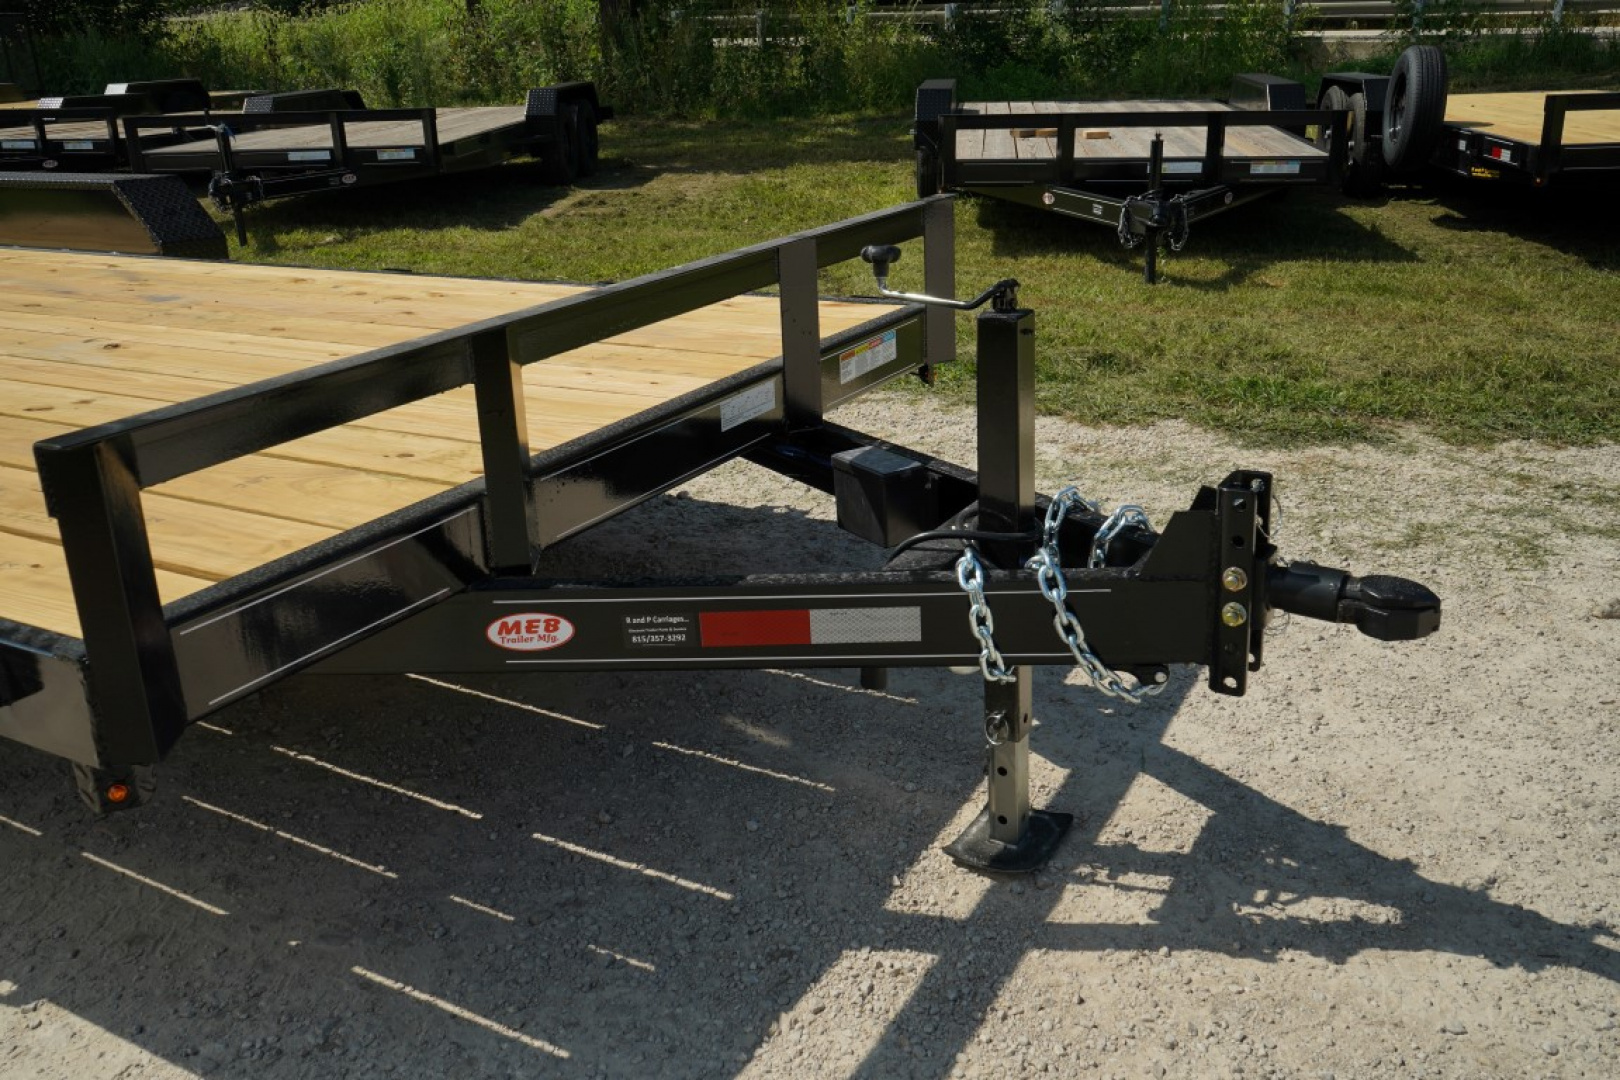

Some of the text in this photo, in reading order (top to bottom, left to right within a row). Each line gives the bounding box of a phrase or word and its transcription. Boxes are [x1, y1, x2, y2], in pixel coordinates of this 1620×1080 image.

[632, 616, 645, 624] and
[497, 618, 561, 636] MEB
[499, 633, 559, 645] Trailer Mfg.
